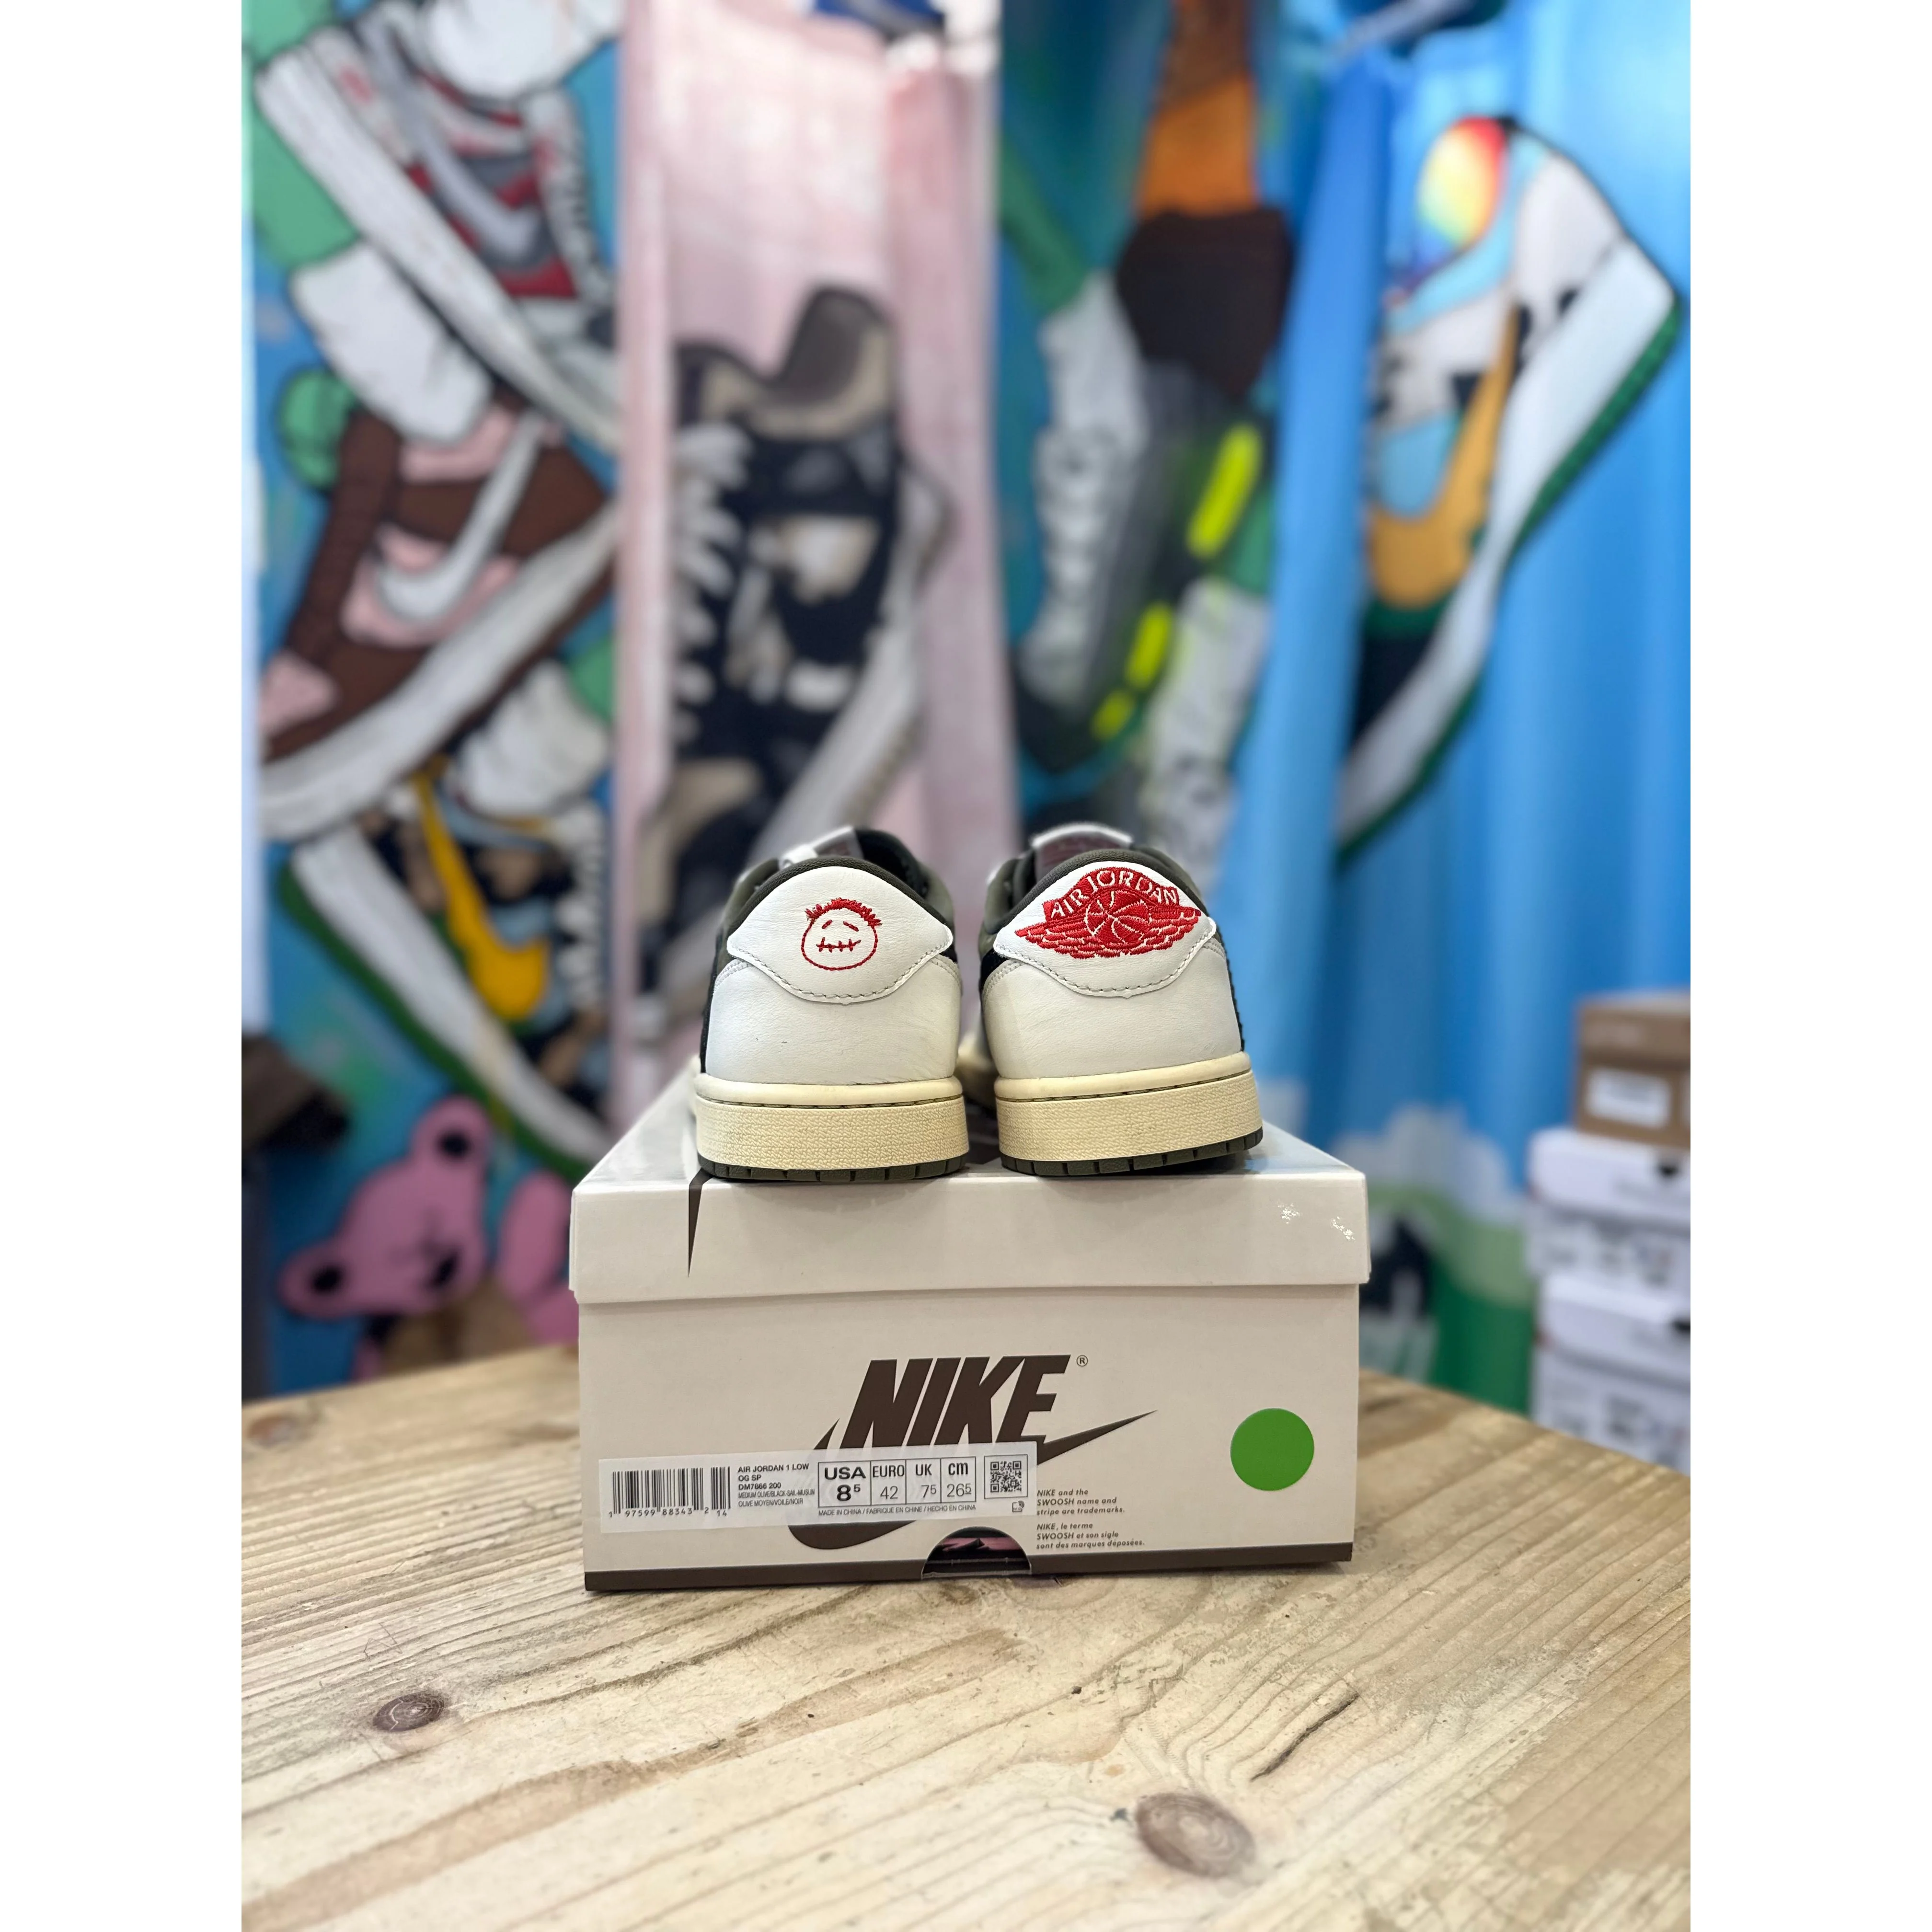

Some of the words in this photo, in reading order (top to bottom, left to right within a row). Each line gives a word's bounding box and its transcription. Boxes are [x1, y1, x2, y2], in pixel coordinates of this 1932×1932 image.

[1051, 888, 1089, 919] AIR
[1086, 870, 1177, 906] JORDAN
[839, 1354, 1071, 1449] NIKE
[825, 1466, 866, 1480] USA
[873, 1464, 905, 1478] EURO
[916, 1464, 932, 1476] UK
[948, 1462, 968, 1475] cm
[880, 1485, 898, 1500] 42
[625, 1509, 656, 1517] 97599
[1037, 1508, 1059, 1516] stripe
[1101, 1530, 1118, 1539] sigle
